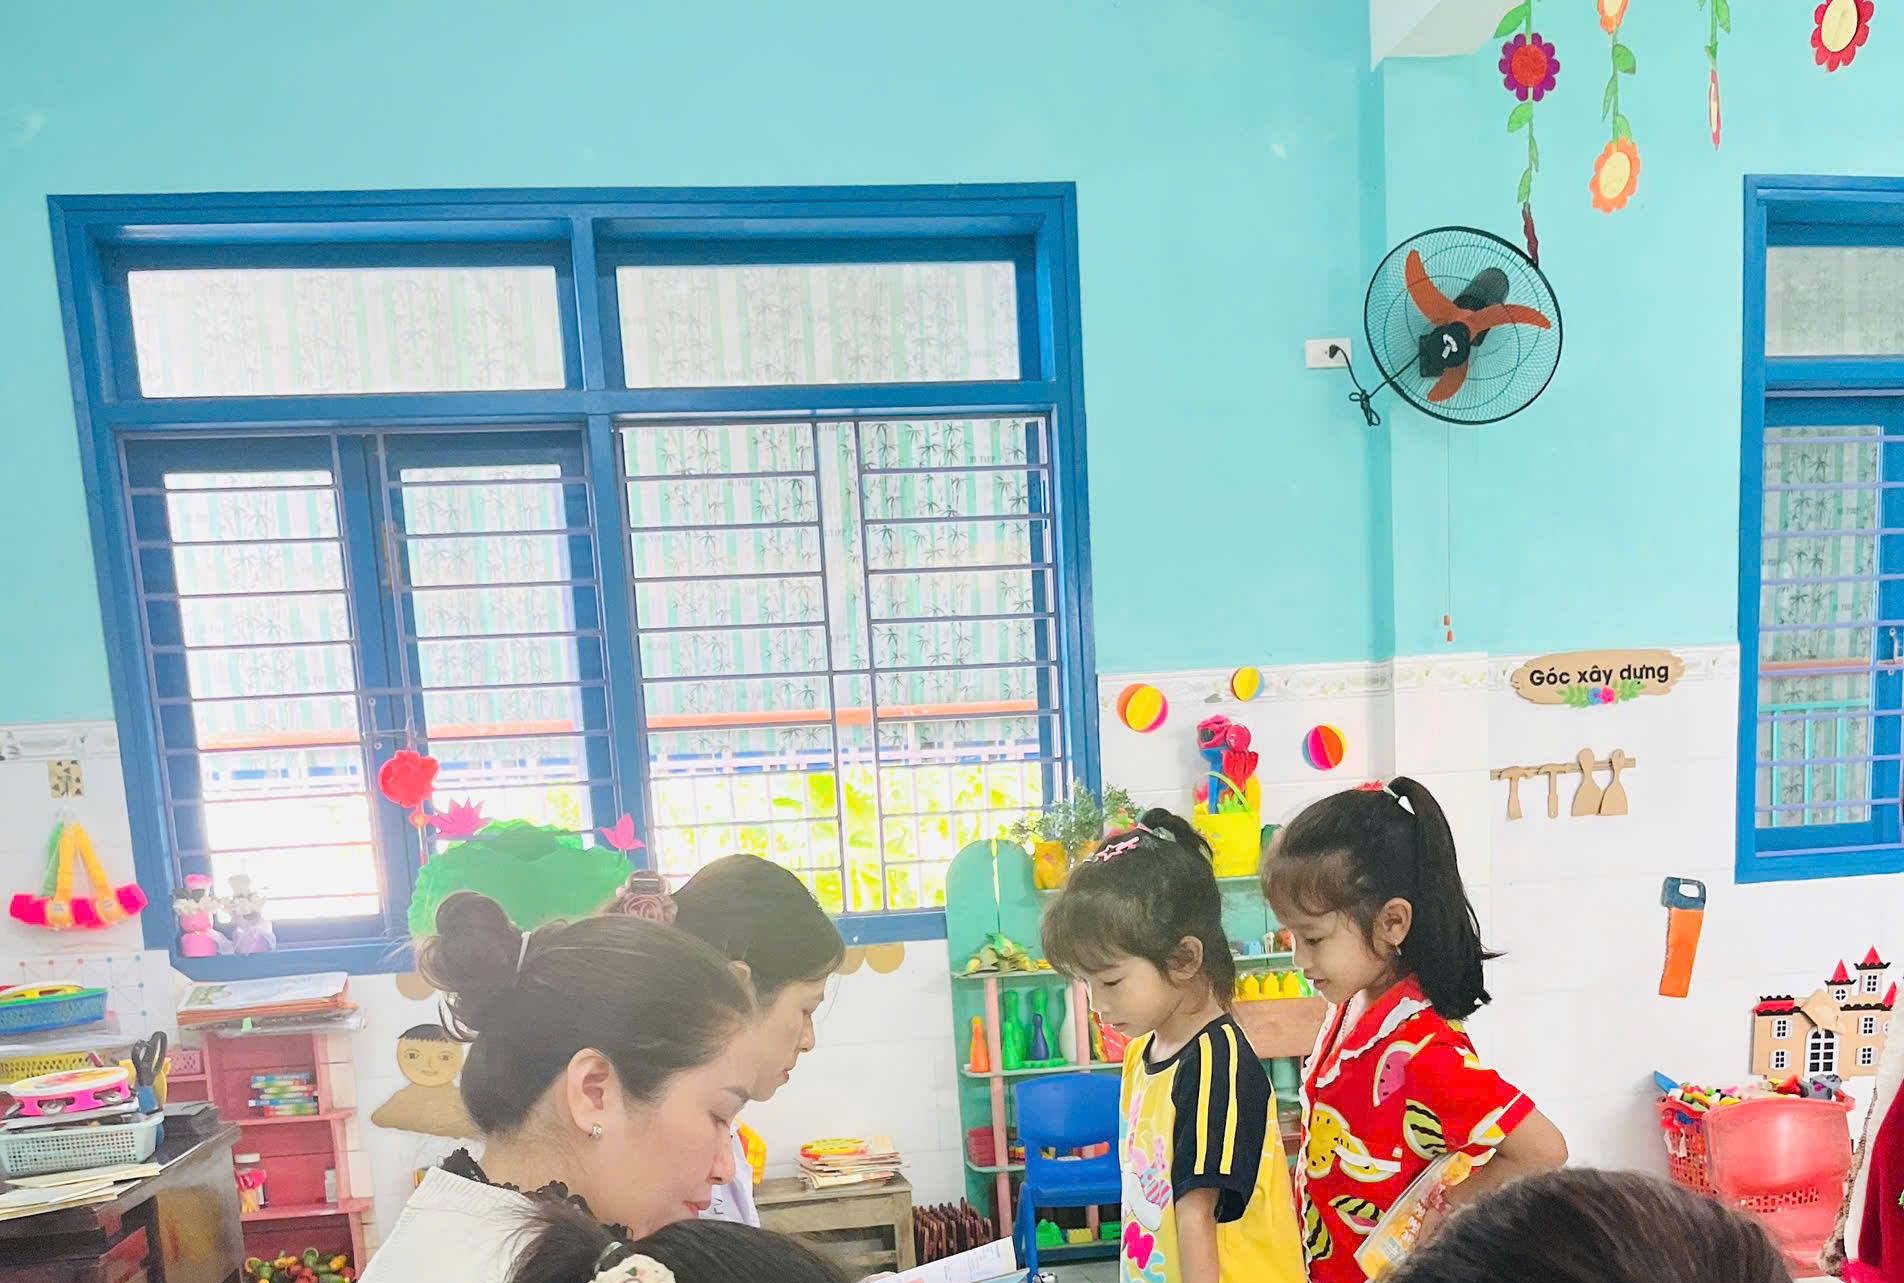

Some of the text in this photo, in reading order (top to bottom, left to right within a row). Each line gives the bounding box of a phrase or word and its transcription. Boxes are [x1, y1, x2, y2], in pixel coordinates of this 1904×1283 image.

[1529, 664, 1669, 686] Góc xây dựng
